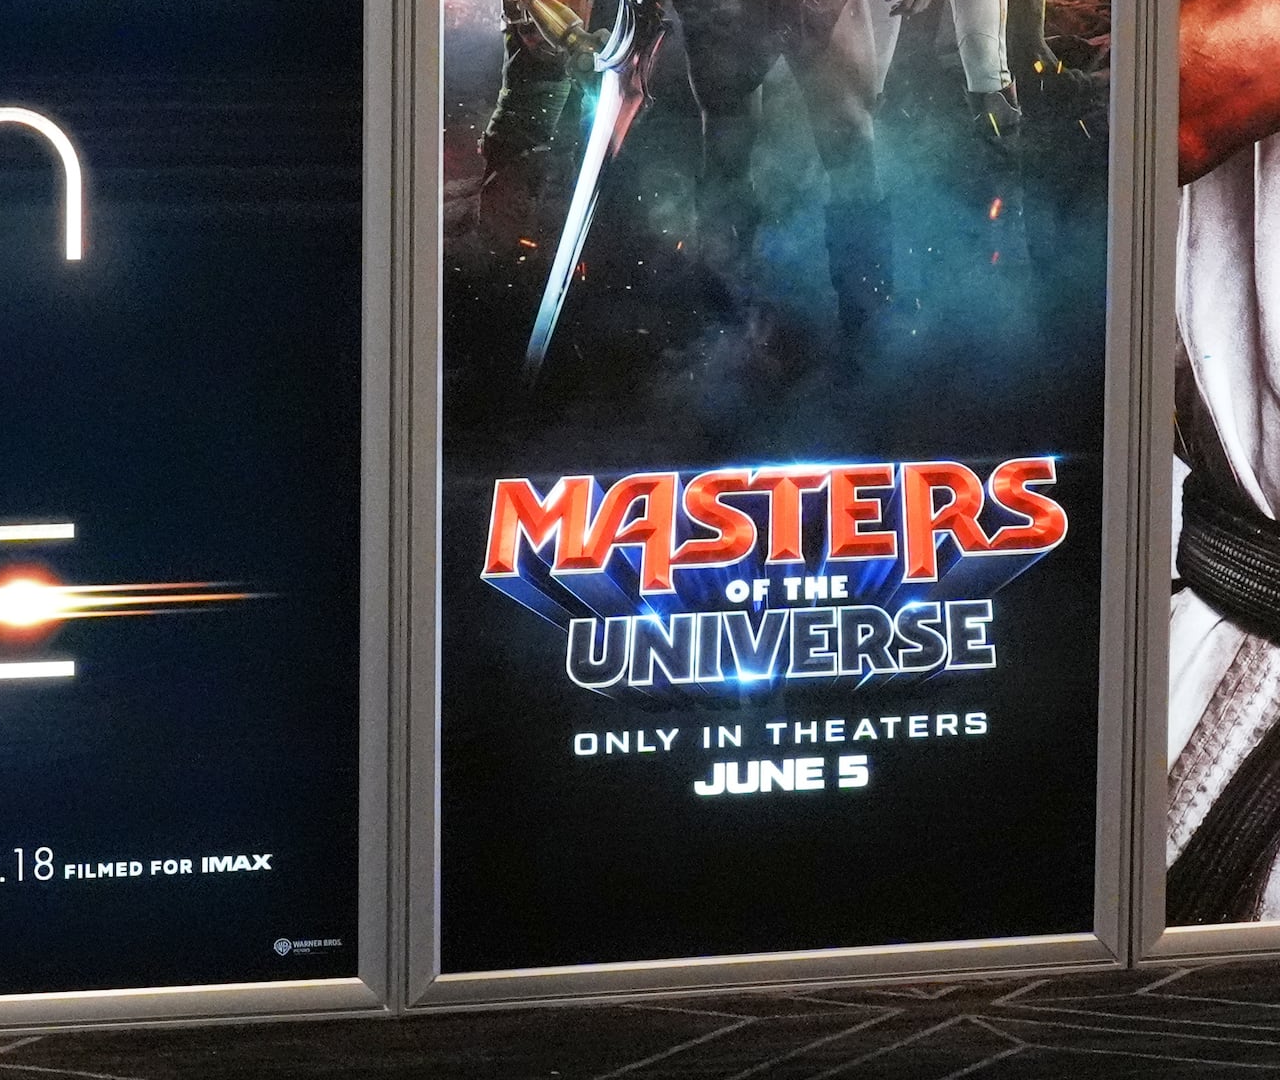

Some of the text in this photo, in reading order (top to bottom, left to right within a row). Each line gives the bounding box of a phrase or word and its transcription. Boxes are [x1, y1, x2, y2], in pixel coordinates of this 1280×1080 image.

[479, 456, 1070, 595] MASTERS
[725, 575, 849, 604] OF THE
[565, 598, 998, 690] UNIVERSE
[573, 712, 989, 758] ONLY IN THEATERS
[693, 754, 869, 797] JUNE 5
[64, 860, 144, 880] FILMED
[150, 856, 194, 876] FOR
[201, 853, 273, 873] IMAX
[293, 940, 322, 948] WARNER
